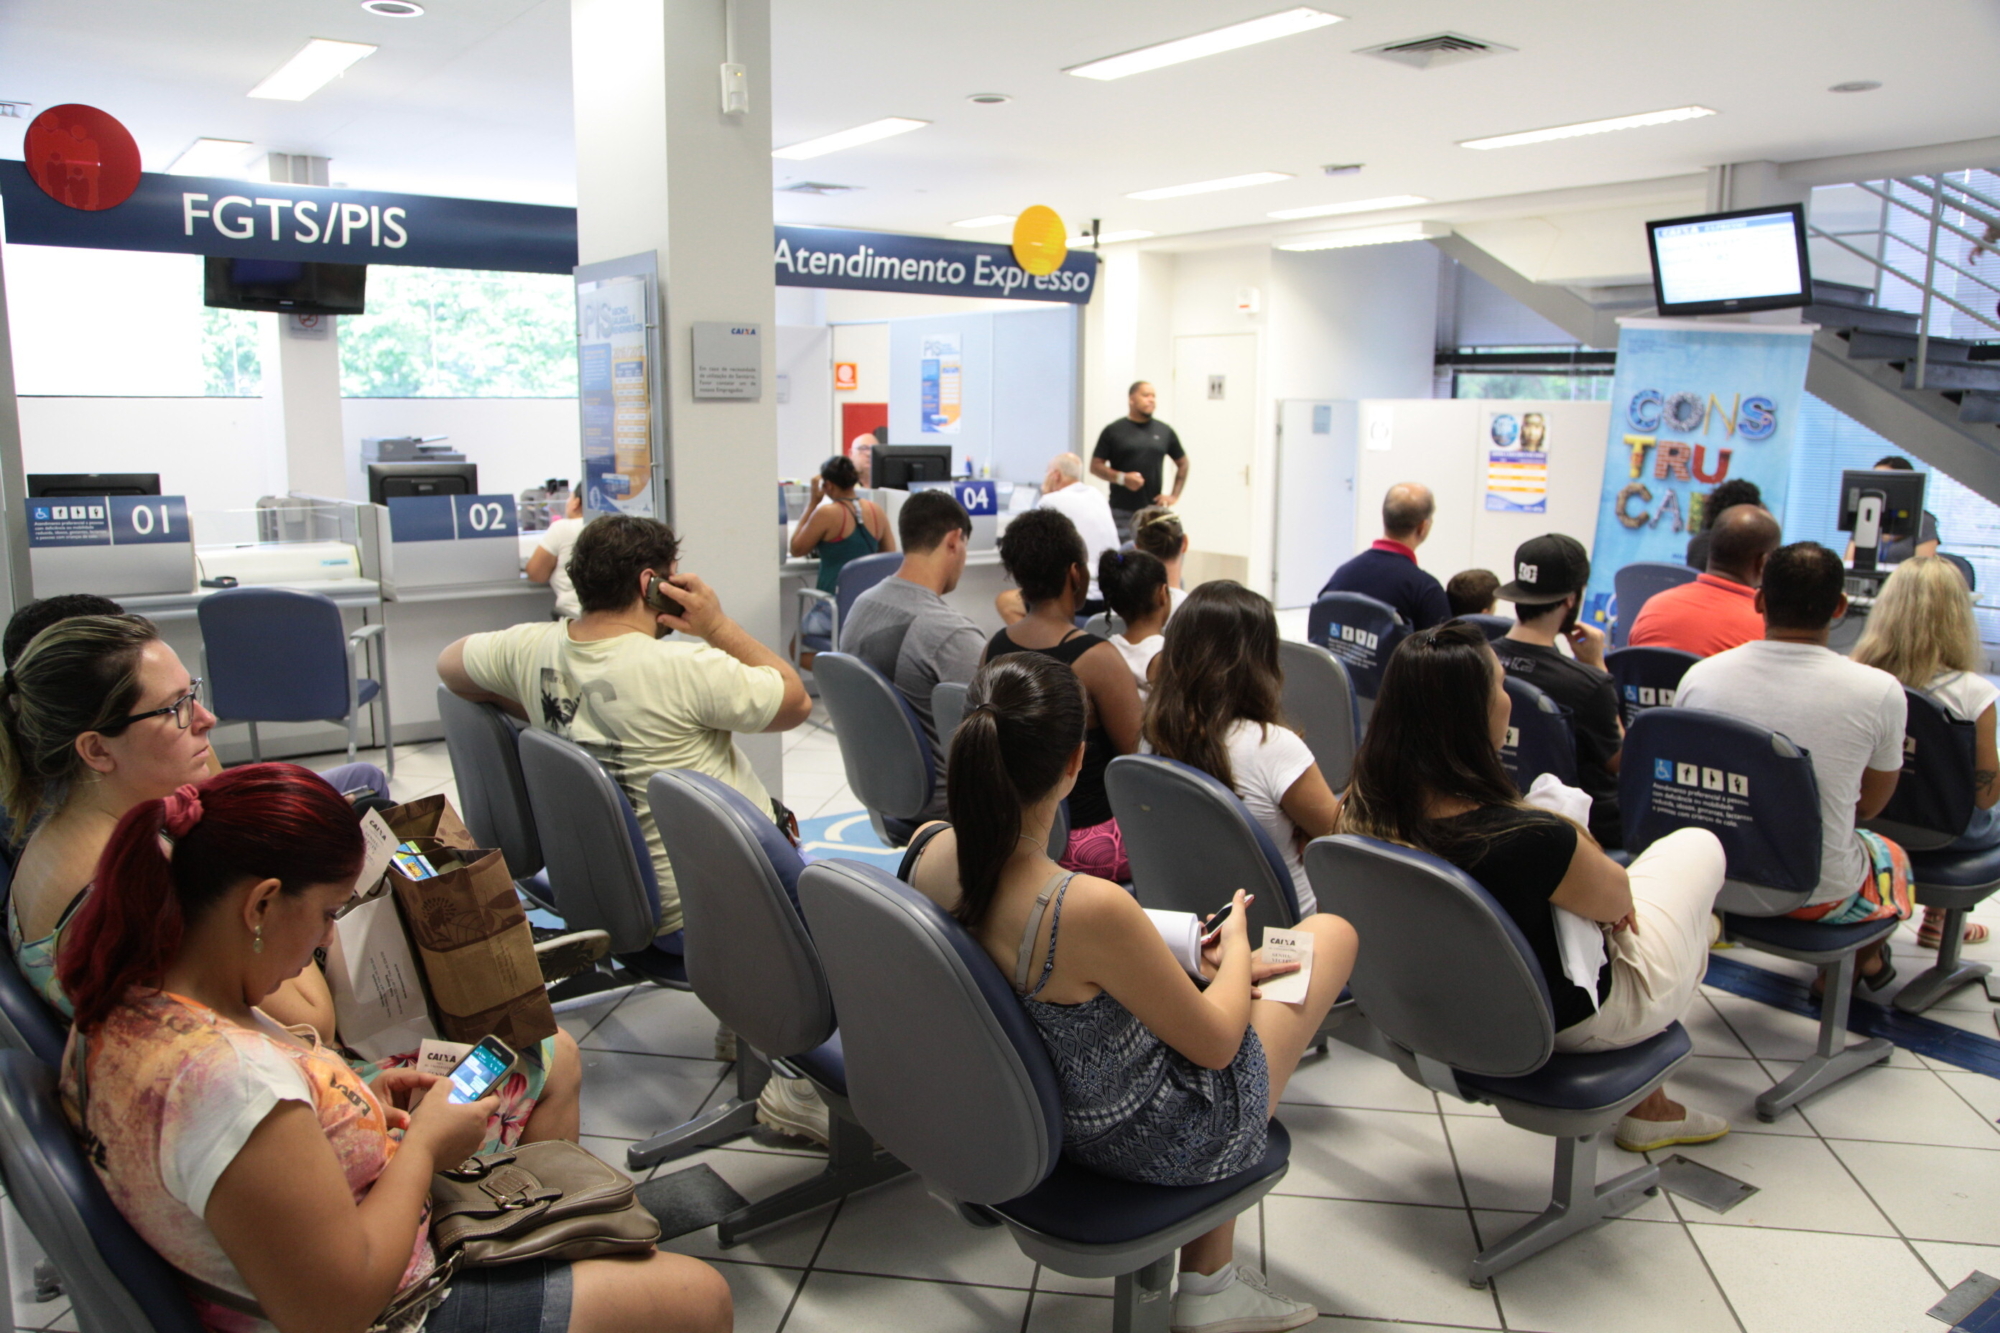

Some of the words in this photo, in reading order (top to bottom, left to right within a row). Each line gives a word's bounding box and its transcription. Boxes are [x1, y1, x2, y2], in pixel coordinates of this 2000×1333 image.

[182, 192, 408, 249] FGTS/PIS
[773, 238, 966, 284] Atendimento
[973, 254, 1090, 296] Expresso
[1626, 388, 1778, 440] CONS
[1623, 434, 1733, 484] TRU
[963, 486, 989, 510] 04
[132, 504, 170, 535] 01
[470, 502, 506, 531] 02
[369, 820, 386, 841] CAIXA
[1270, 938, 1296, 946] CAIXA
[427, 1052, 456, 1063] CAIXA
